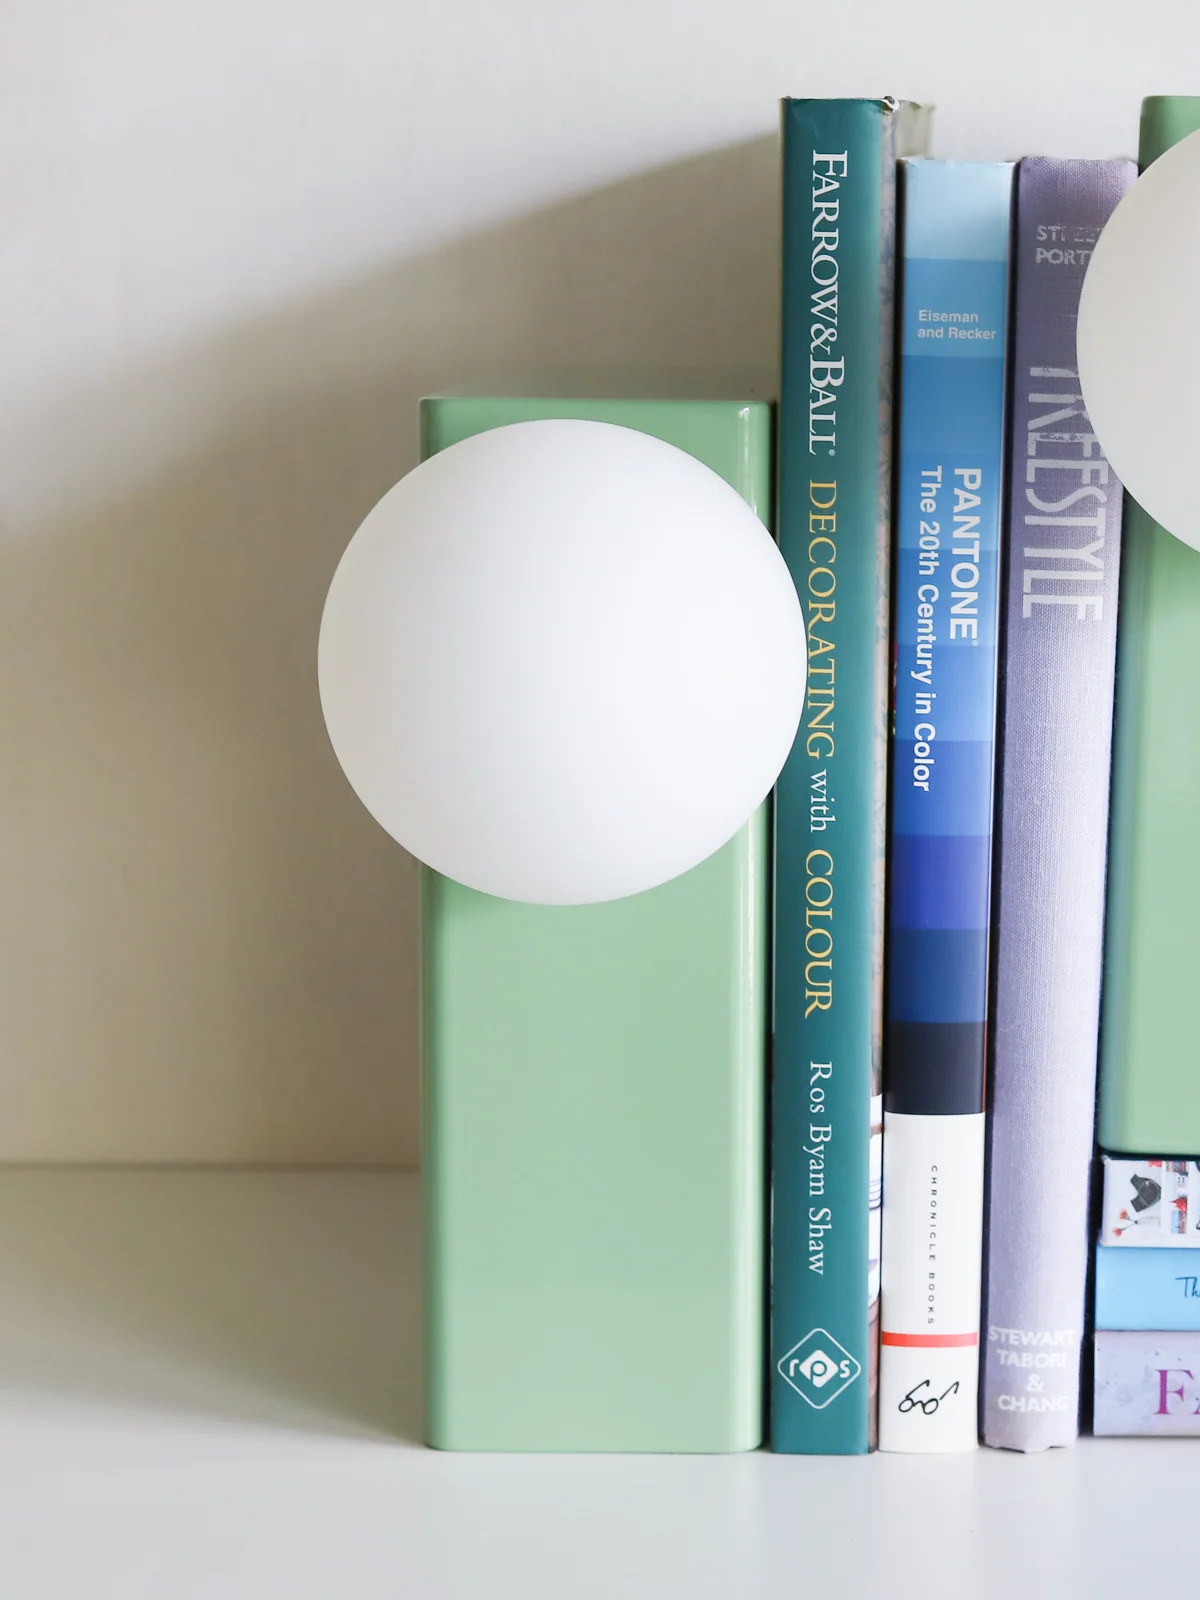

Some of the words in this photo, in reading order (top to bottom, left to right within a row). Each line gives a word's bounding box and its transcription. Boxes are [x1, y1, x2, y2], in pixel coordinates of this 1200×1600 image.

[917, 308, 979, 323] Eiseman
[917, 326, 944, 340] and
[948, 327, 997, 341] Recker
[919, 464, 943, 513] The
[917, 520, 941, 576] 20th
[805, 479, 837, 760] DECORATING
[910, 583, 939, 686] Century
[914, 691, 937, 715] in
[912, 722, 936, 792] Color
[809, 768, 836, 833] with
[804, 848, 834, 1020] COLOUR
[807, 1060, 833, 1115] Ros
[802, 1123, 832, 1197] Byam
[928, 1164, 939, 1262] CHRONICLE
[807, 1207, 832, 1276] Shaw
[927, 1271, 936, 1325] BOOKS
[996, 1349, 1068, 1368] TABORI
[1026, 1373, 1045, 1392] &
[997, 1394, 1069, 1413] CHANG
